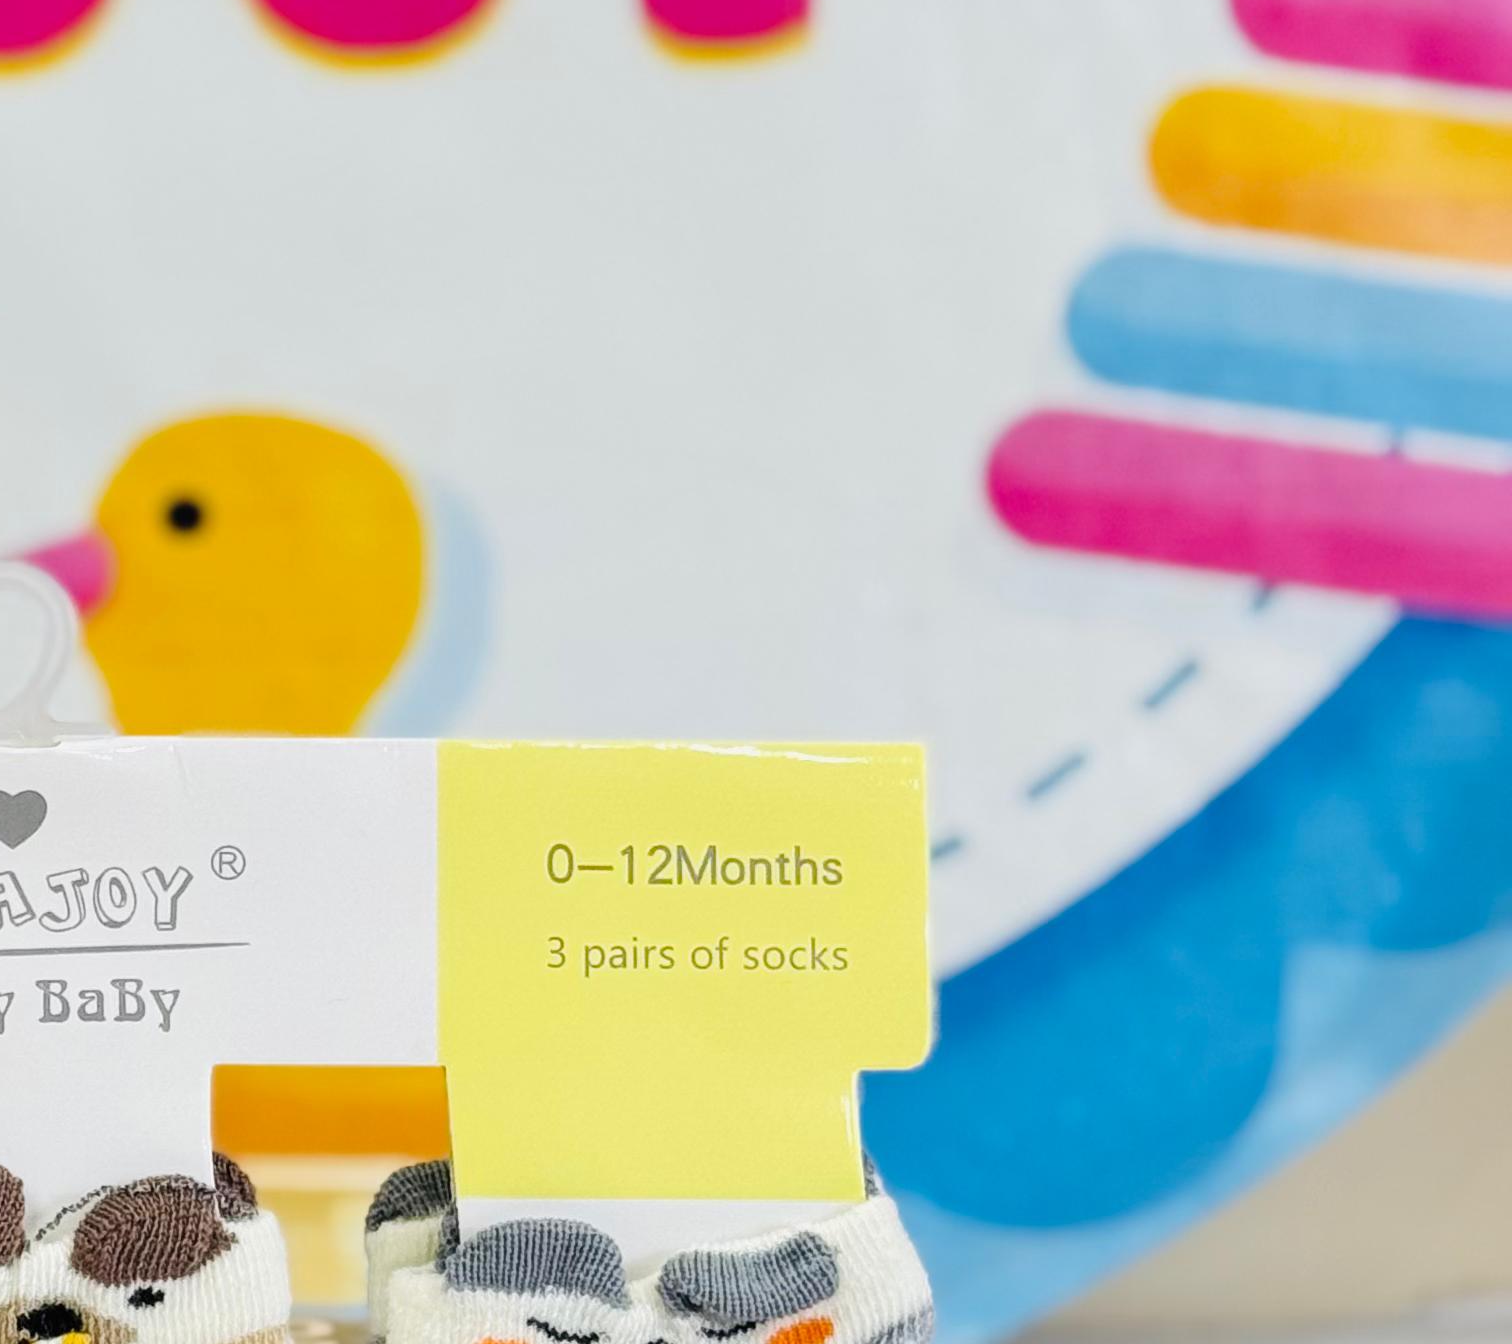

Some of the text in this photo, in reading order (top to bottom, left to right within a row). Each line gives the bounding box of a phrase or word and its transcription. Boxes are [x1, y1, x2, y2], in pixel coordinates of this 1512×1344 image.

[545, 935, 849, 979] 3 pairs of socks
[35, 978, 182, 1034] BaBy
